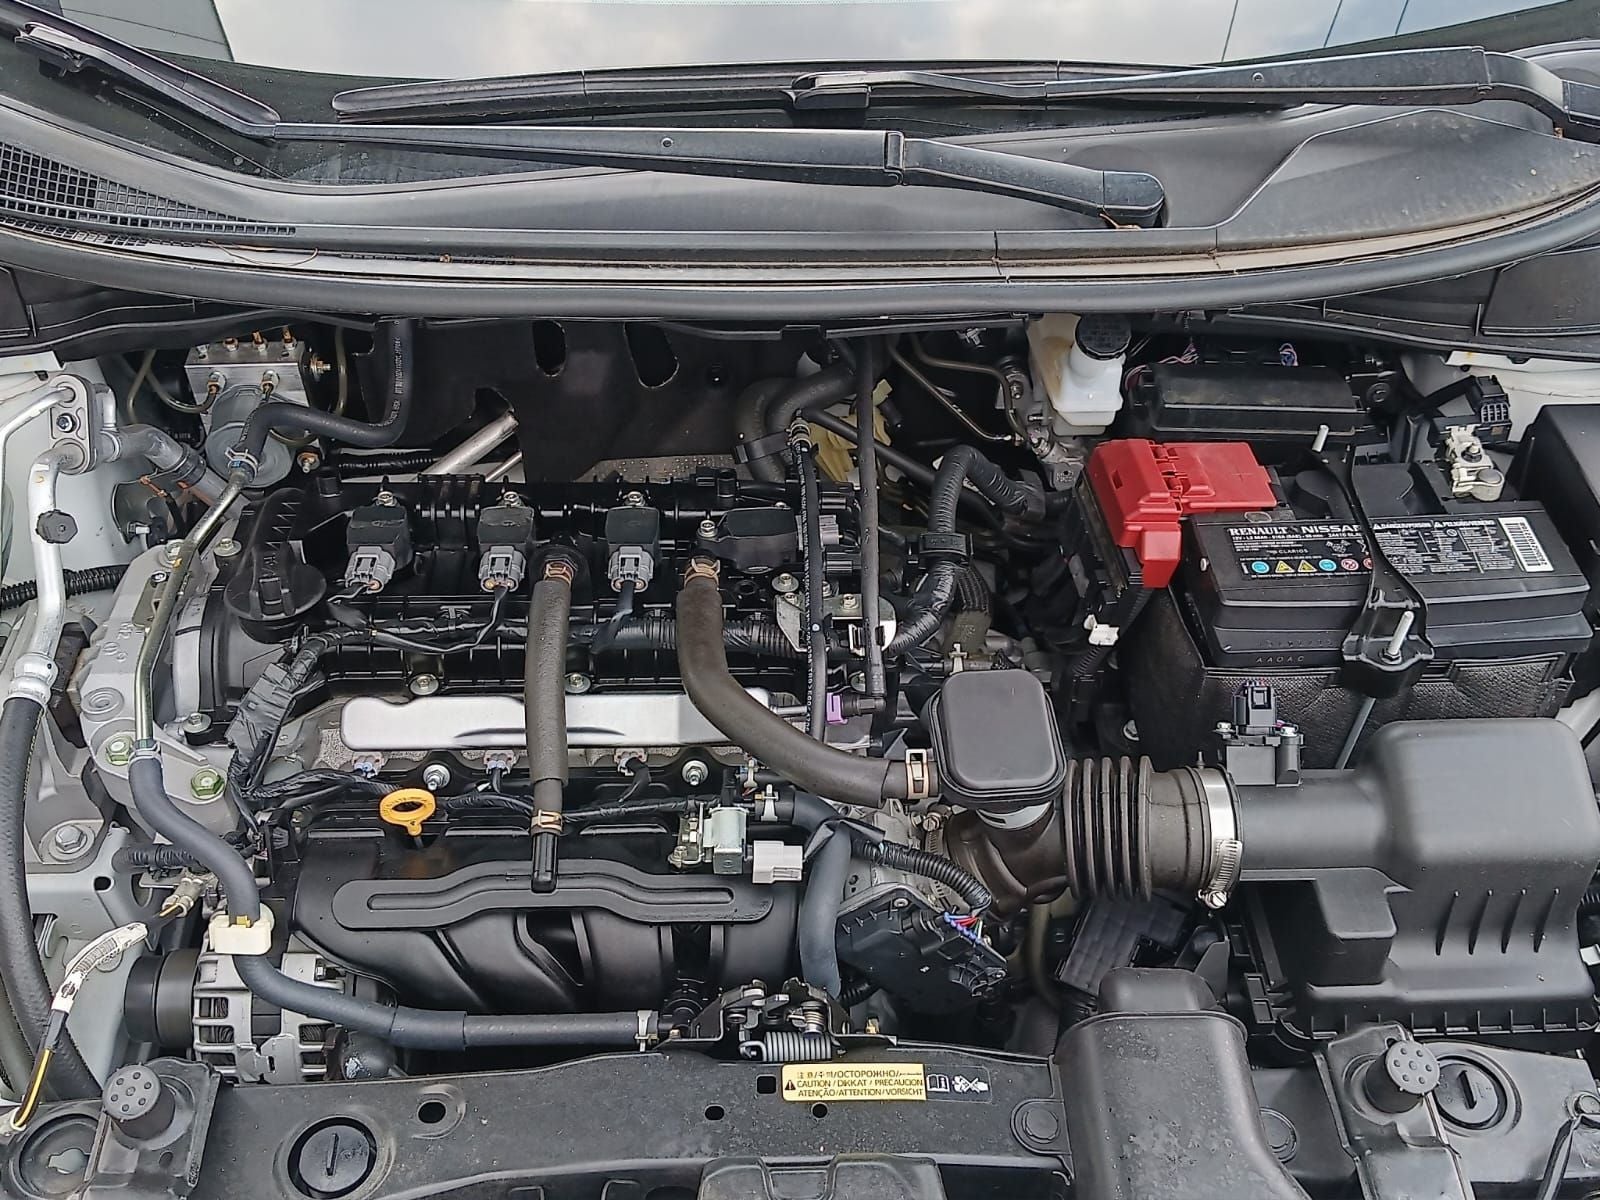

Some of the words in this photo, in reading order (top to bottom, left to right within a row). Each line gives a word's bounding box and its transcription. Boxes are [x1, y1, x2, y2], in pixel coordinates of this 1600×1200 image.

[1228, 526, 1288, 536] RENAULT
[797, 1079, 831, 1088] CAUTION
[837, 1079, 867, 1087] DIKKAT
